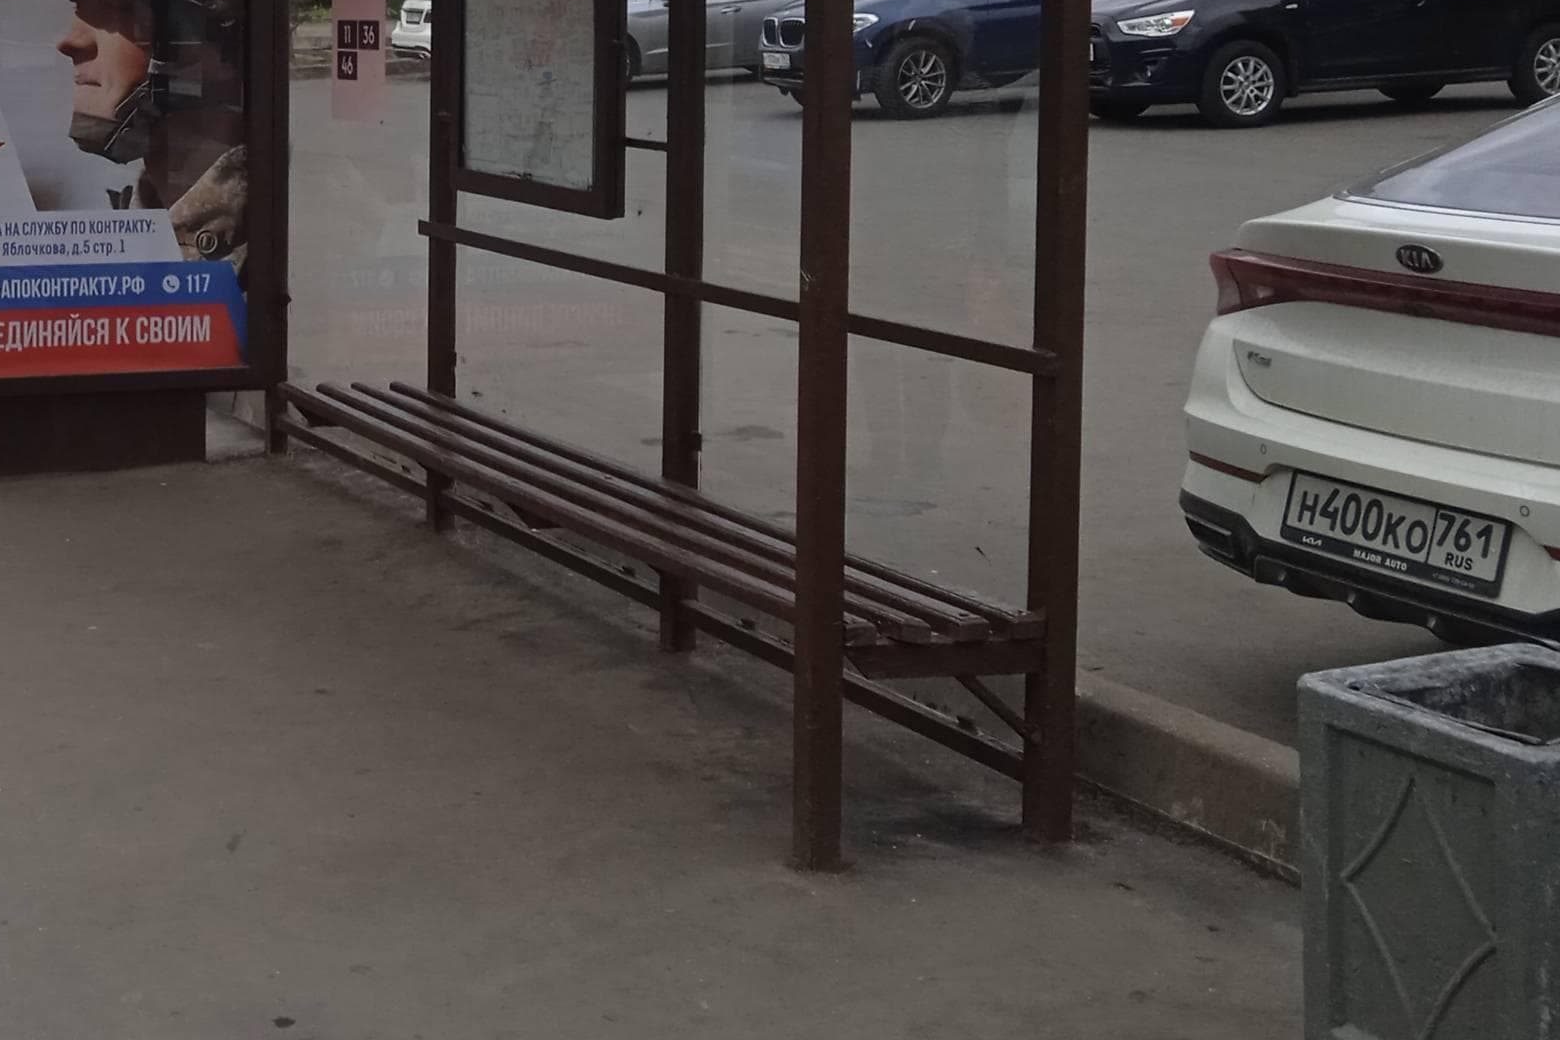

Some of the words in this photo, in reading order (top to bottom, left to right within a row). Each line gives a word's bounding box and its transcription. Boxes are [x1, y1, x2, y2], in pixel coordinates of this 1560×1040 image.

[344, 25, 351, 43] 11
[363, 25, 375, 44] 36
[341, 56, 353, 75] 46
[5, 222, 20, 236] НА
[22, 221, 68, 236] СЛУЖБУ
[71, 221, 86, 234] ПО
[90, 219, 156, 234] КОНТРАКТУ:
[3, 242, 70, 257] Яблочкова,
[72, 240, 90, 255] д.5
[93, 242, 117, 256] стр.
[120, 239, 126, 253] 1
[1400, 248, 1435, 270] KIA
[187, 274, 211, 294] 117
[116, 317, 130, 345] К
[136, 315, 211, 344] СВОИМ
[1437, 512, 1494, 560] 761
[1353, 549, 1383, 565] MAJOR
[1385, 559, 1407, 572] AUTO
[1445, 552, 1473, 571] RUS
